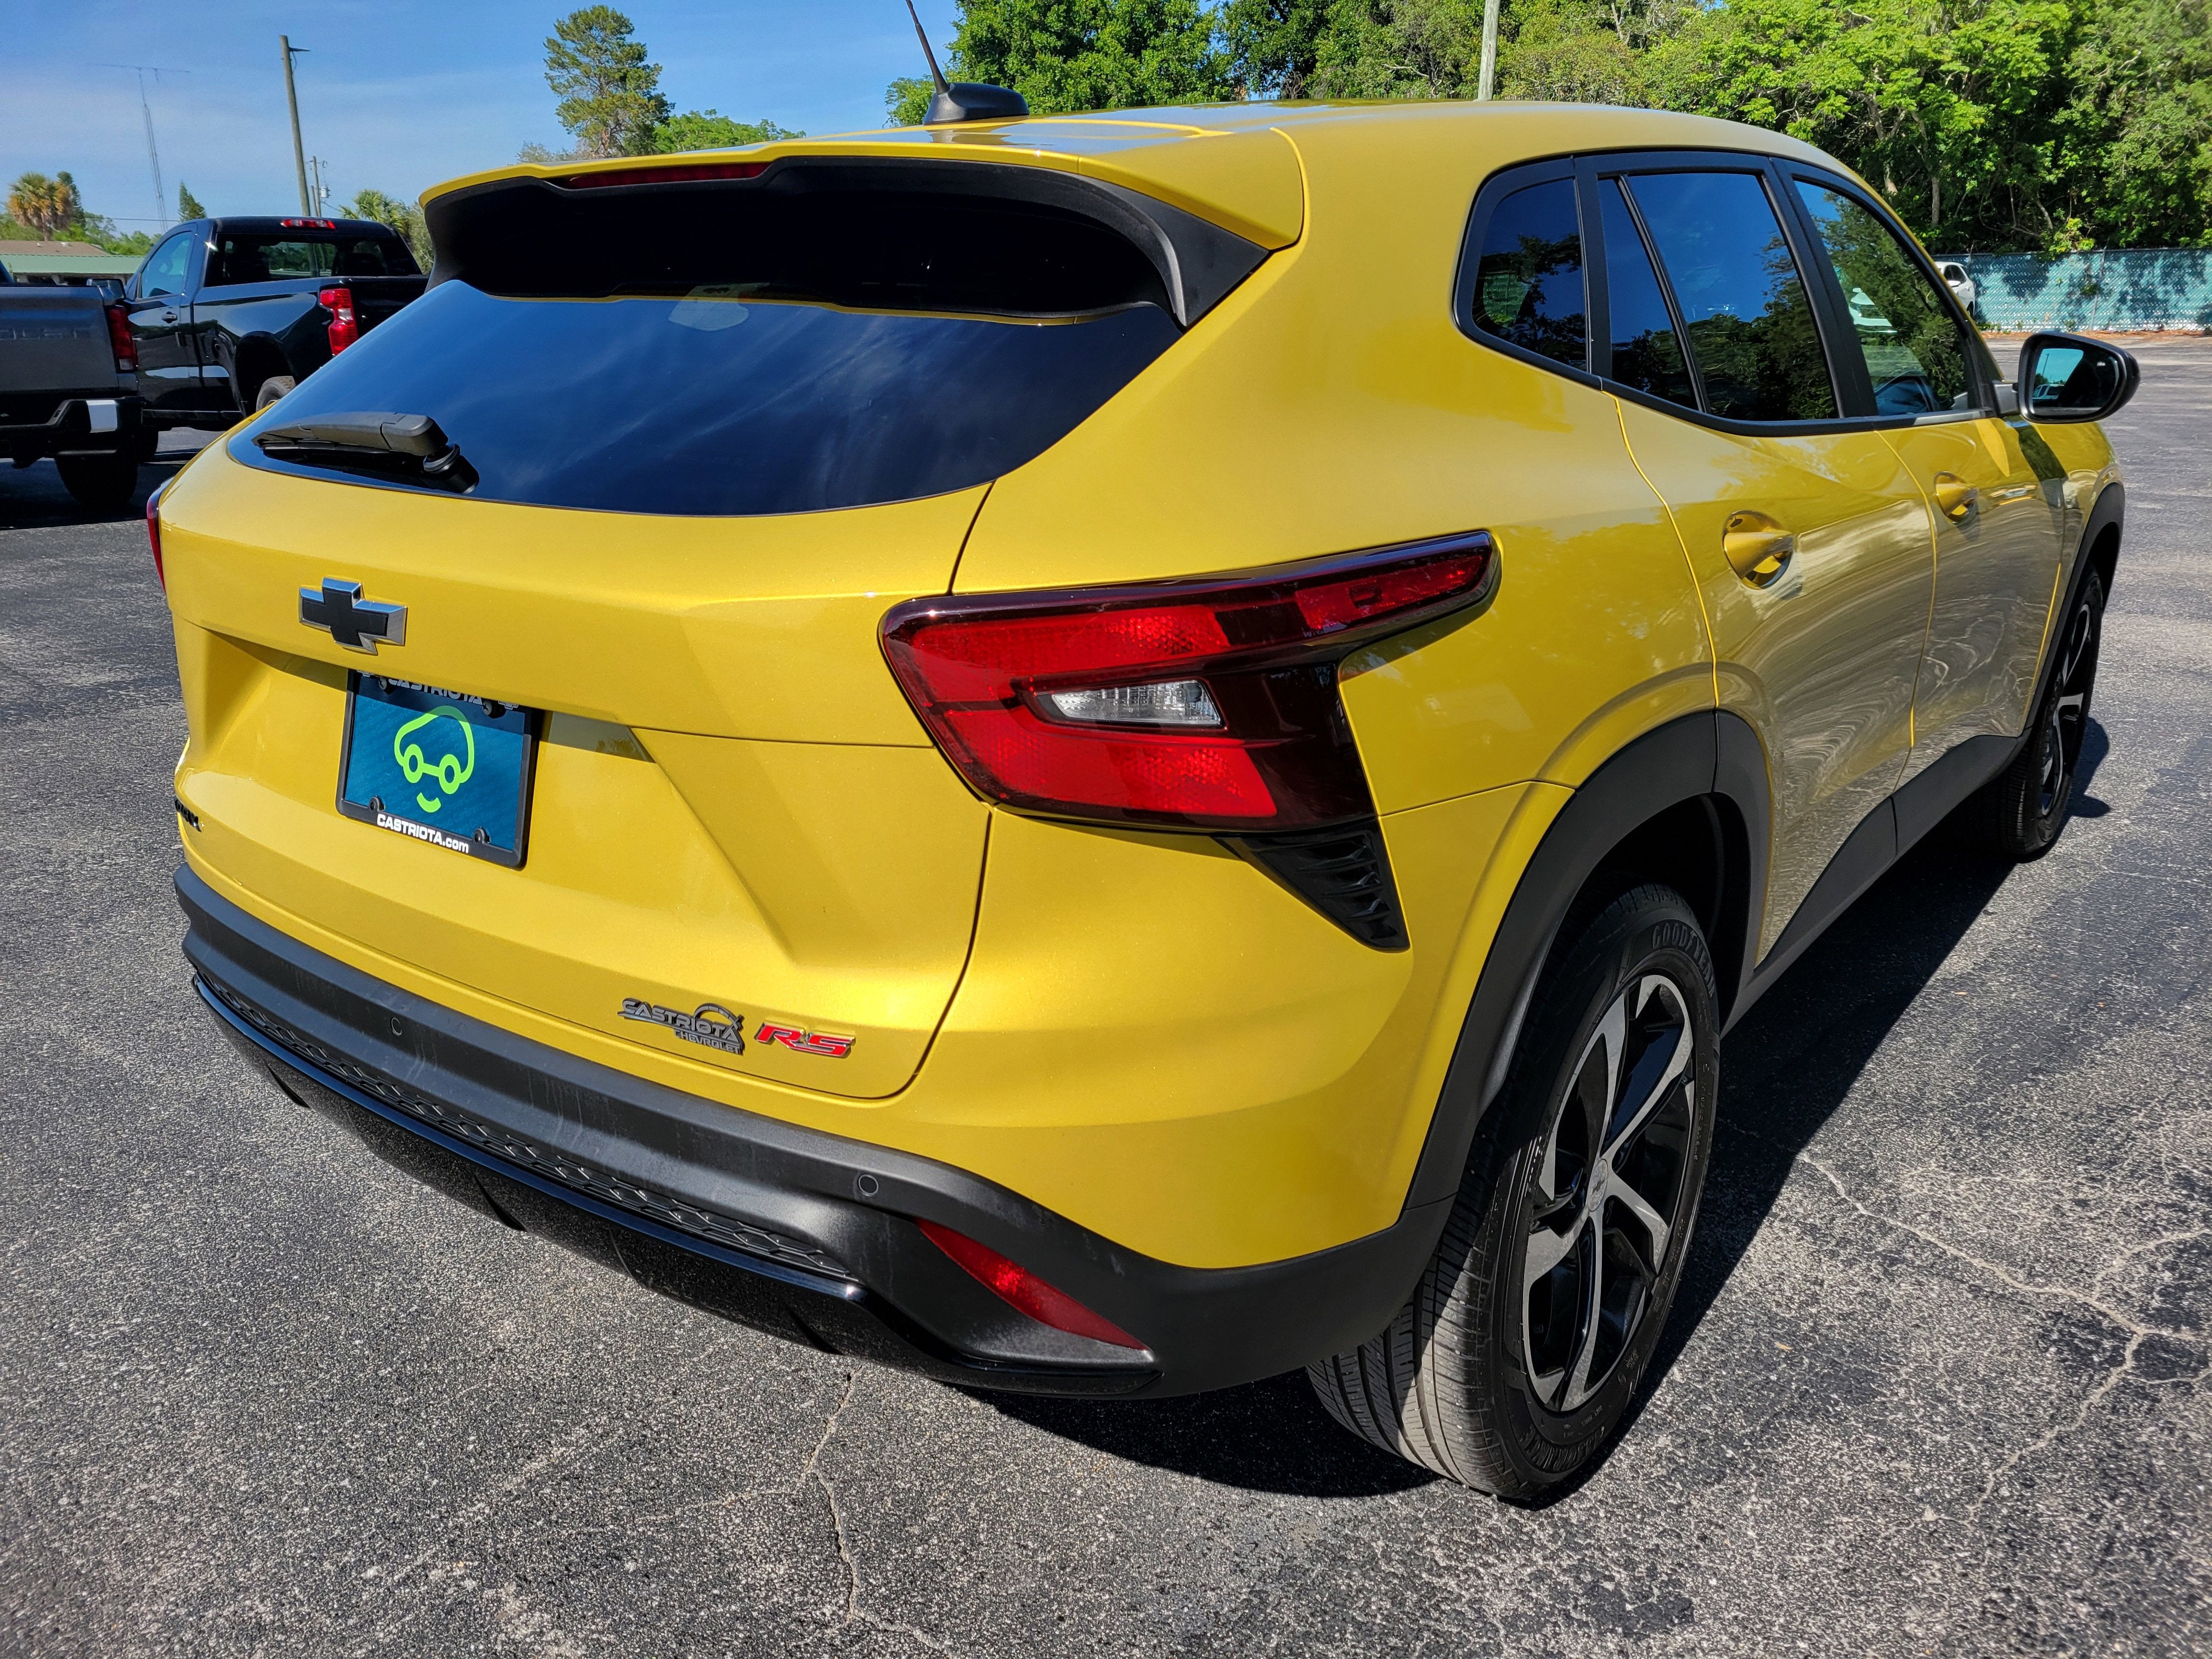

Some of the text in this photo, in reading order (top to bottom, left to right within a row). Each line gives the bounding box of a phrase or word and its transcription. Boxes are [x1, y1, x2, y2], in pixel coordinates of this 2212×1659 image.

[377, 813, 469, 854] CASTRIOTA.com
[622, 997, 741, 1045] CASTRIOTA
[754, 1022, 856, 1058] RS
[674, 1028, 742, 1056] CHEVROLET
